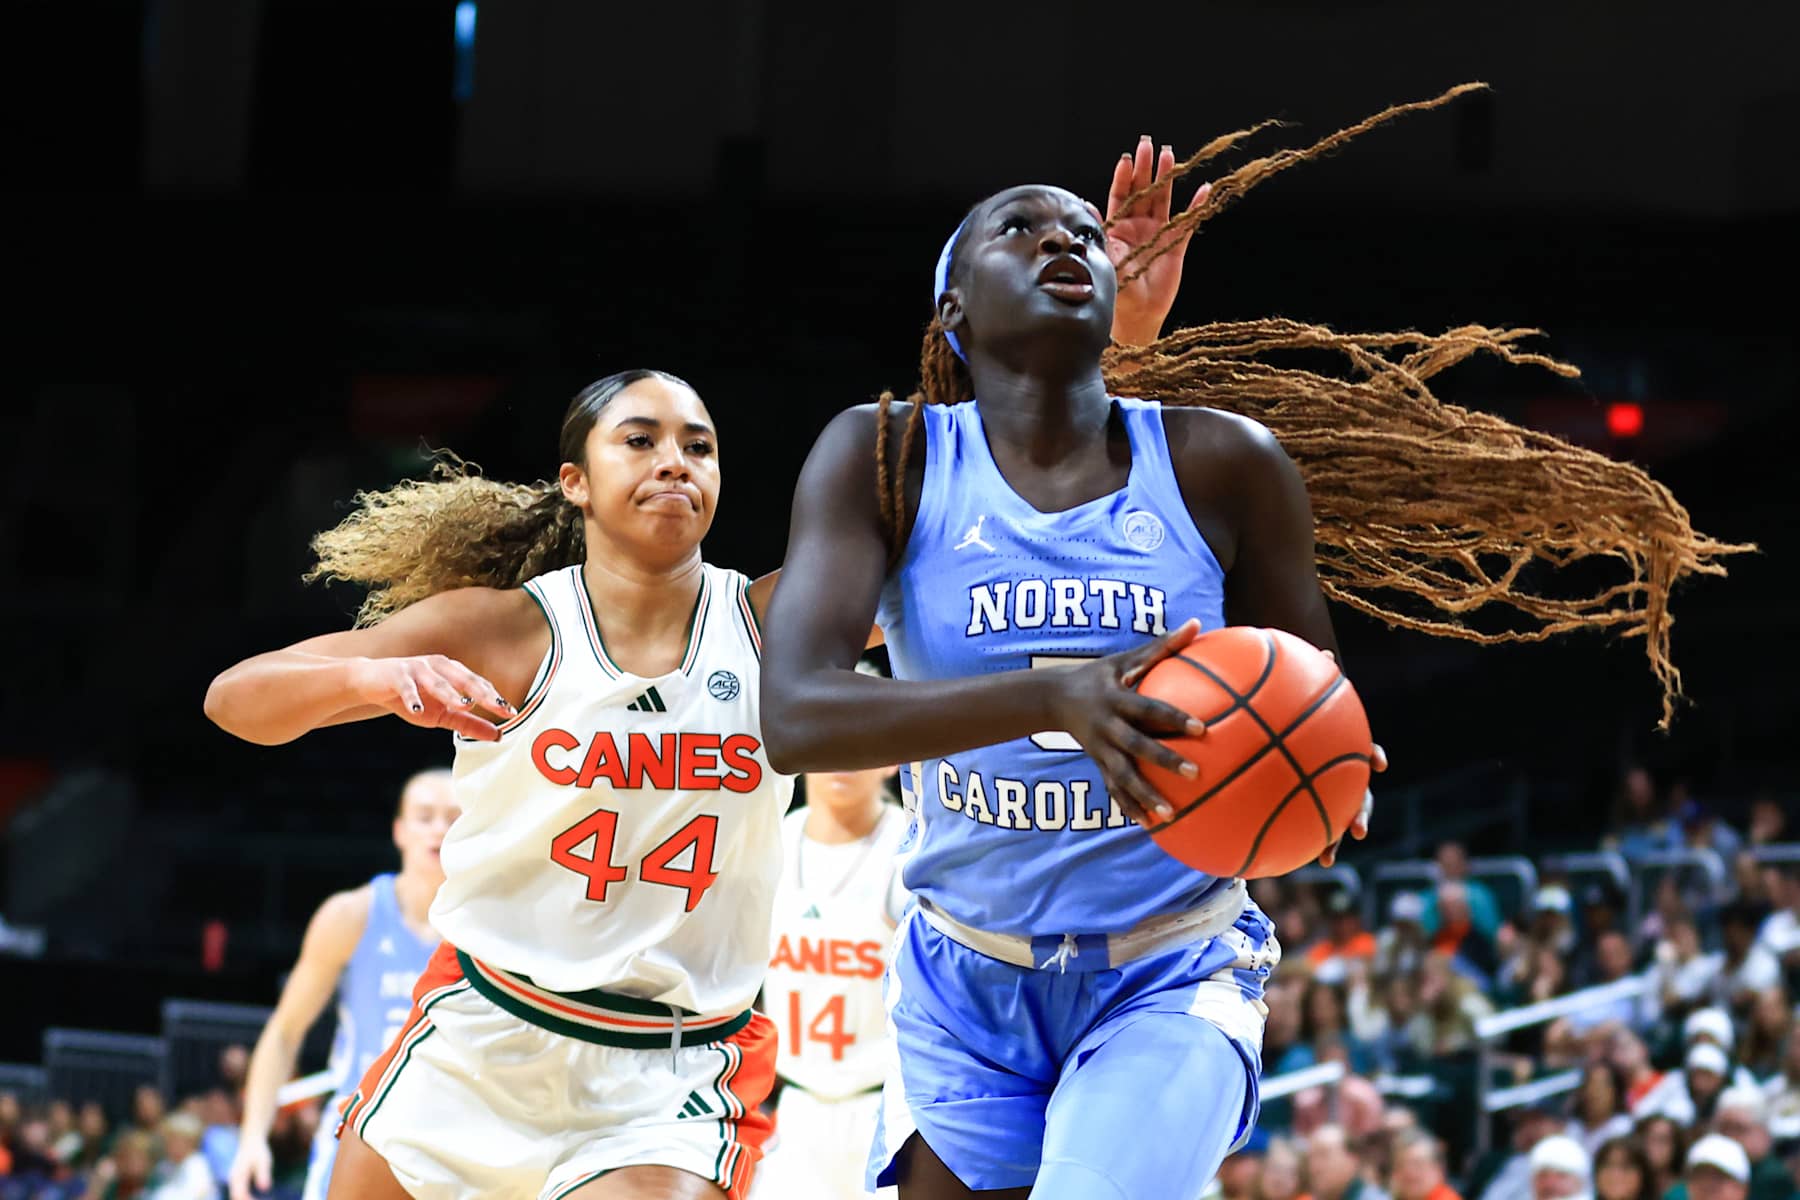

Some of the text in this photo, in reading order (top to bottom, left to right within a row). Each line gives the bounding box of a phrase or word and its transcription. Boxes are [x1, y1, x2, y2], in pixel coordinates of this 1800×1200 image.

[966, 577, 1168, 638] NORTH
[531, 728, 763, 793] CANES
[937, 758, 1137, 831] CAROLI
[550, 808, 719, 912] 44
[768, 933, 886, 981] ANES
[788, 990, 857, 1062] 14
